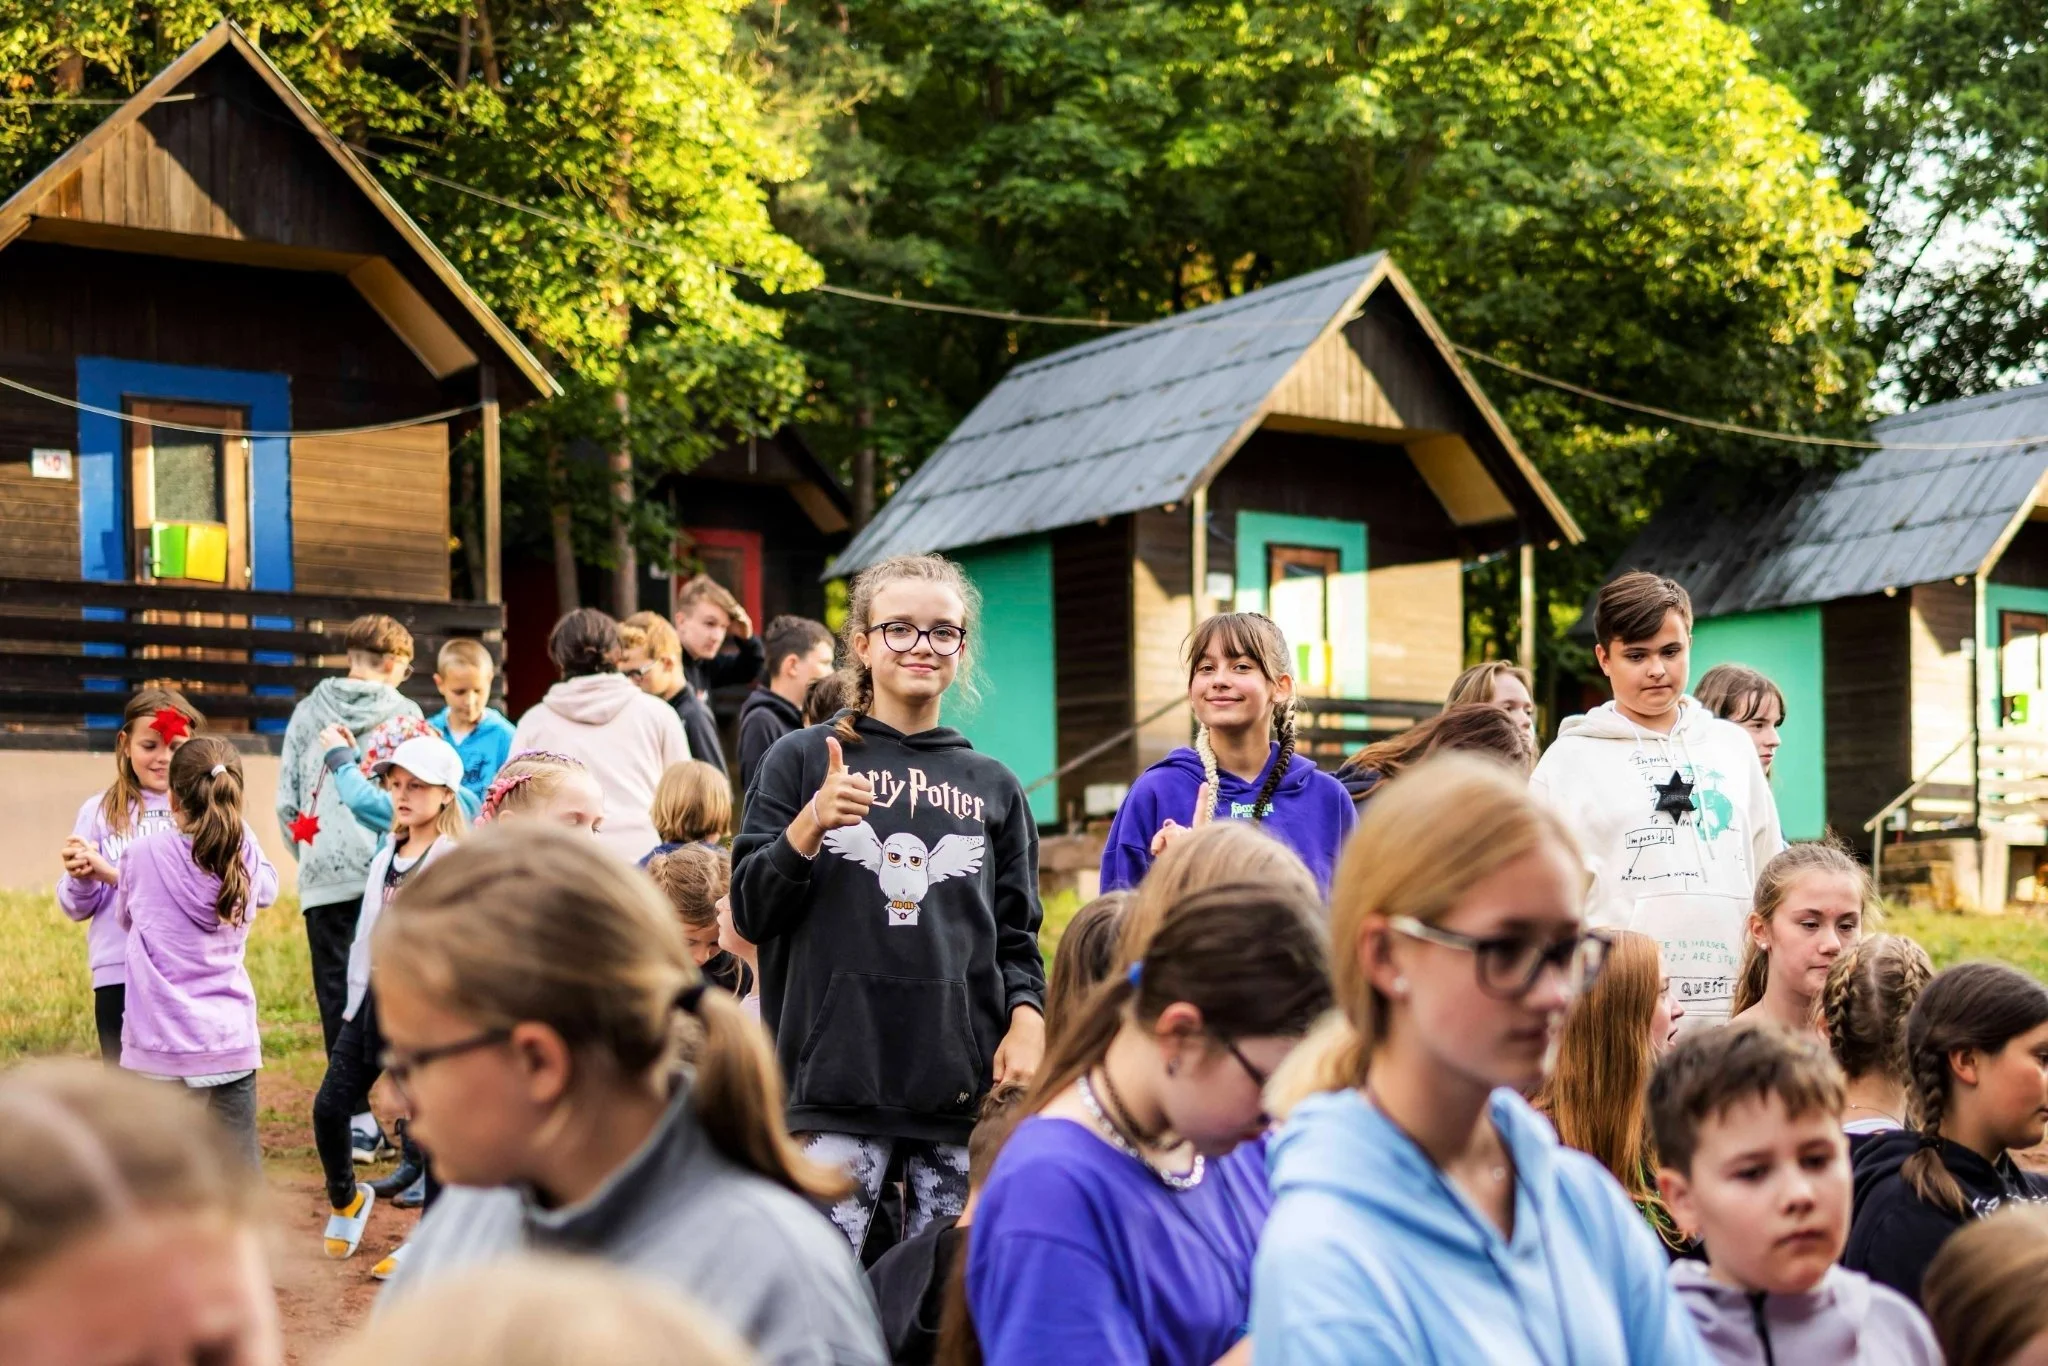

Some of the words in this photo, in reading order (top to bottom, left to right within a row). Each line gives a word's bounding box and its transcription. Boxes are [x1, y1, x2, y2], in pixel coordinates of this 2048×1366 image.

[844, 765, 906, 808] rry
[908, 767, 985, 822] Potter
[1628, 829, 1672, 845] Impossible
[1692, 952, 1712, 963] ARE
